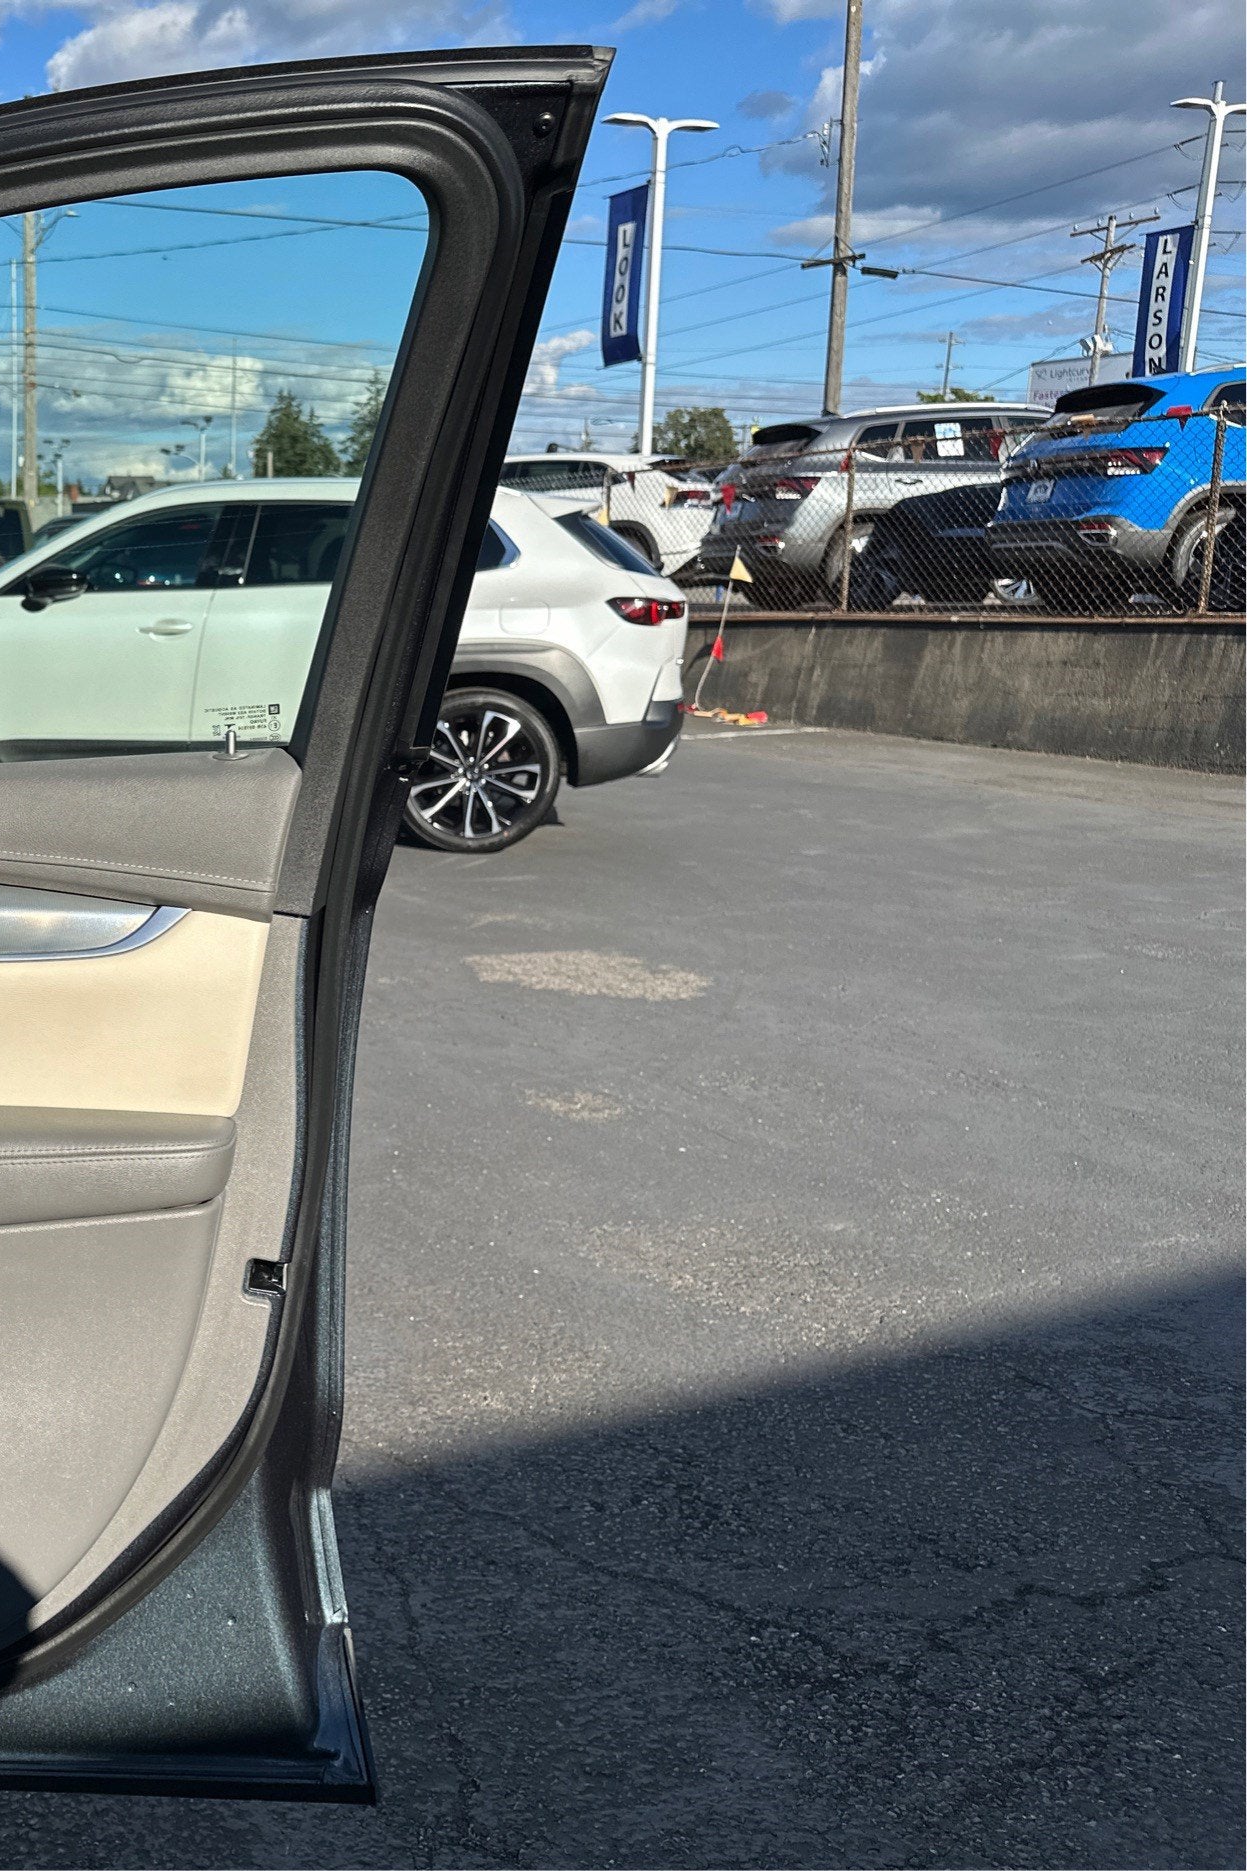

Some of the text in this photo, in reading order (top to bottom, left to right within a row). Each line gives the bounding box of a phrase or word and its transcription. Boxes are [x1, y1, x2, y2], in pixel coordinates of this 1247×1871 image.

[613, 228, 630, 332] LOOK
[1148, 238, 1172, 375] LARSON
[1049, 366, 1090, 381] Lightcurv
